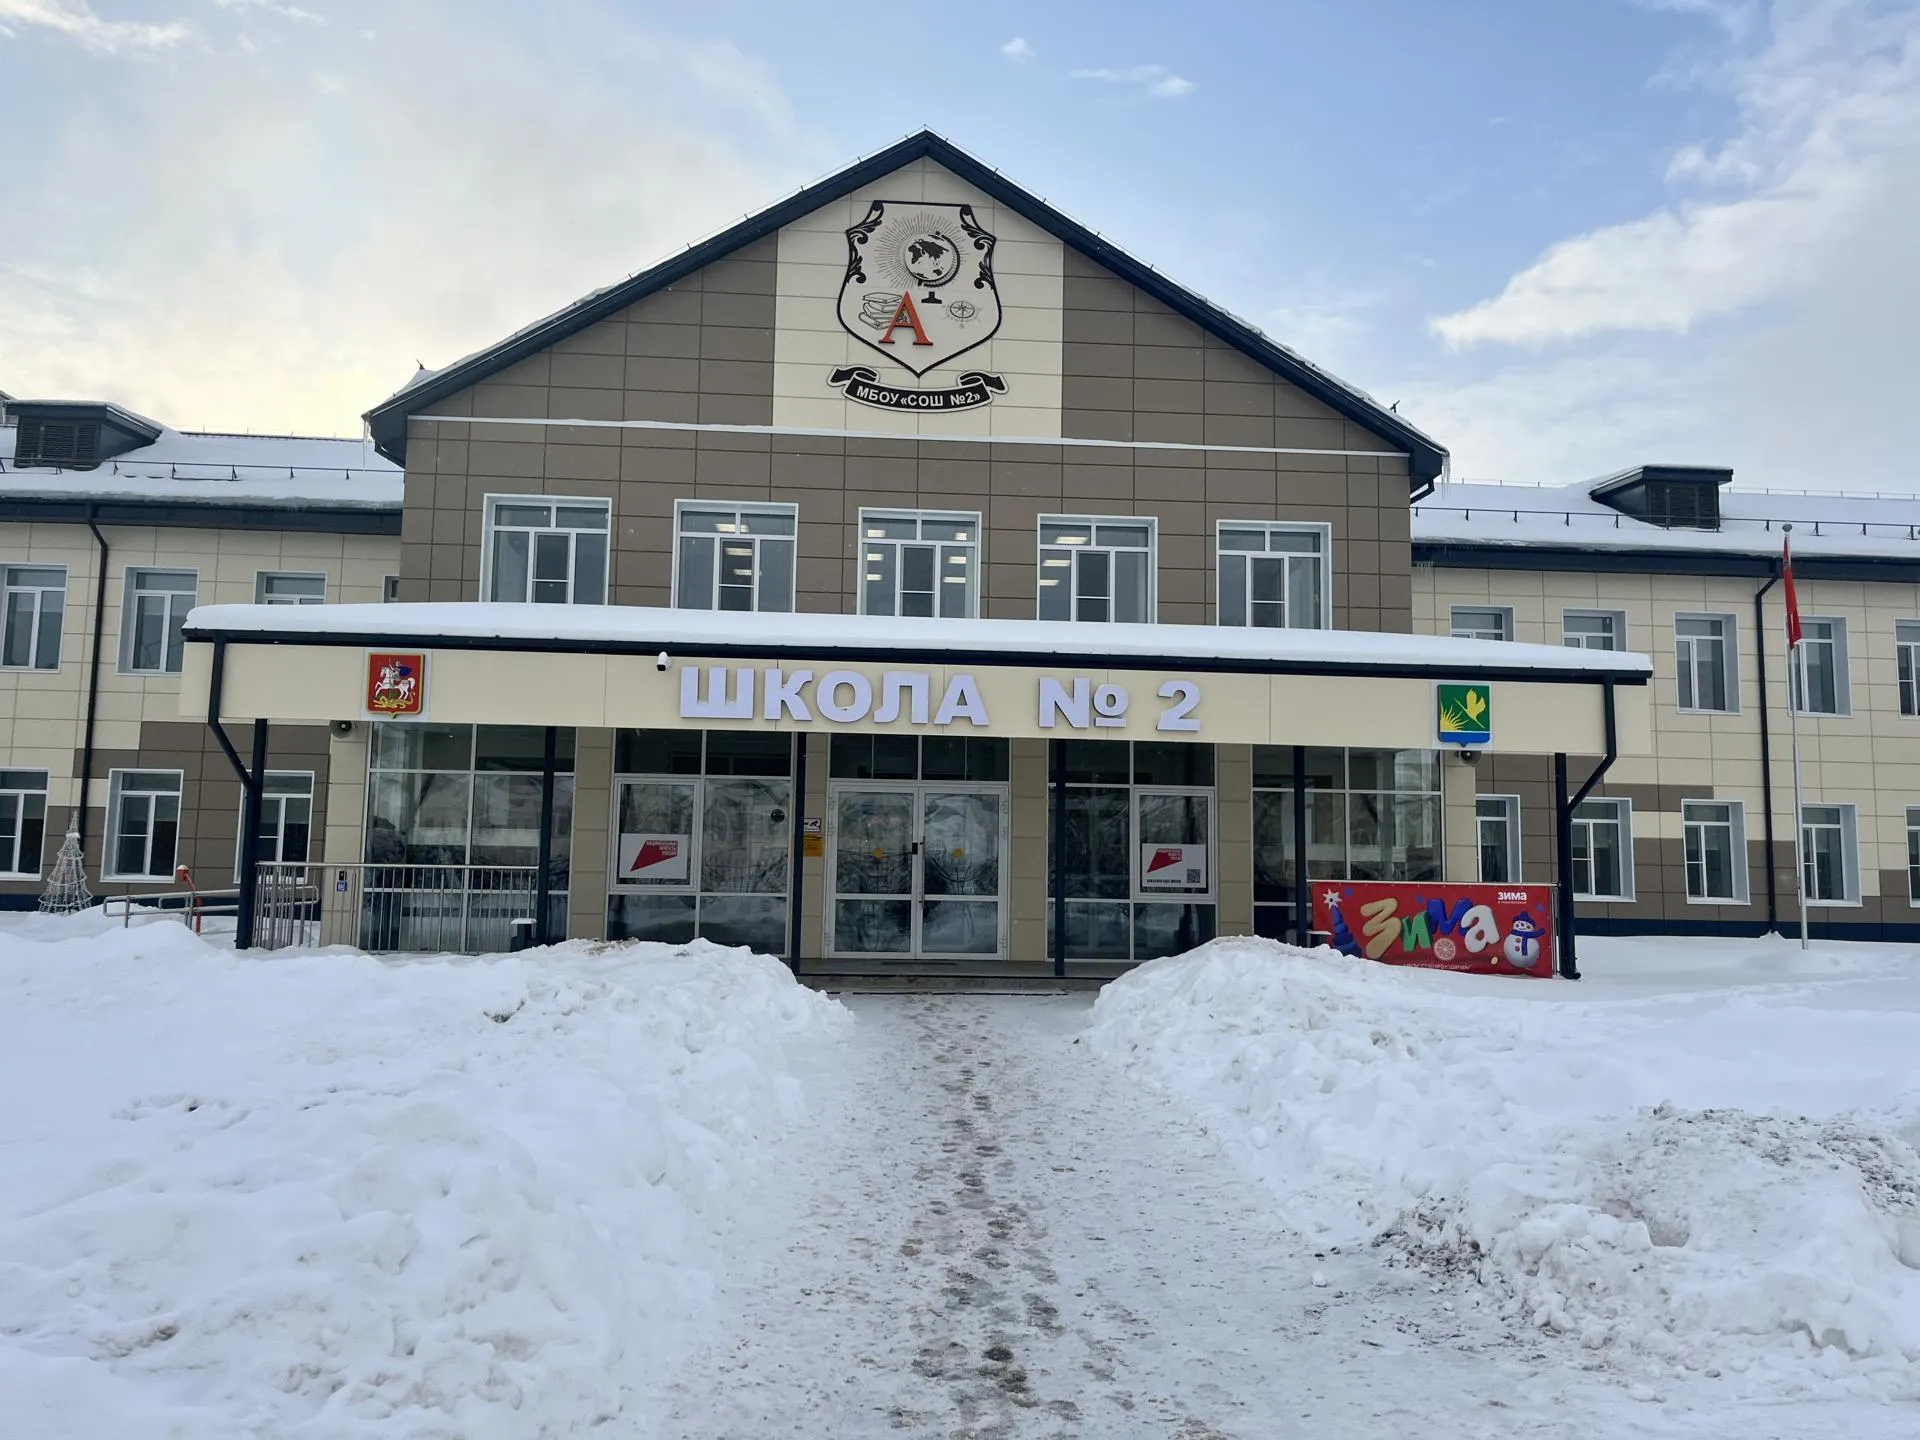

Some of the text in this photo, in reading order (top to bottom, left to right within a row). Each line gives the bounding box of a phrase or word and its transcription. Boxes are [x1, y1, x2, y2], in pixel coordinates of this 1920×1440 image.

[950, 391, 980, 406] №2»
[680, 666, 1201, 732] ШКОЛА № 2
